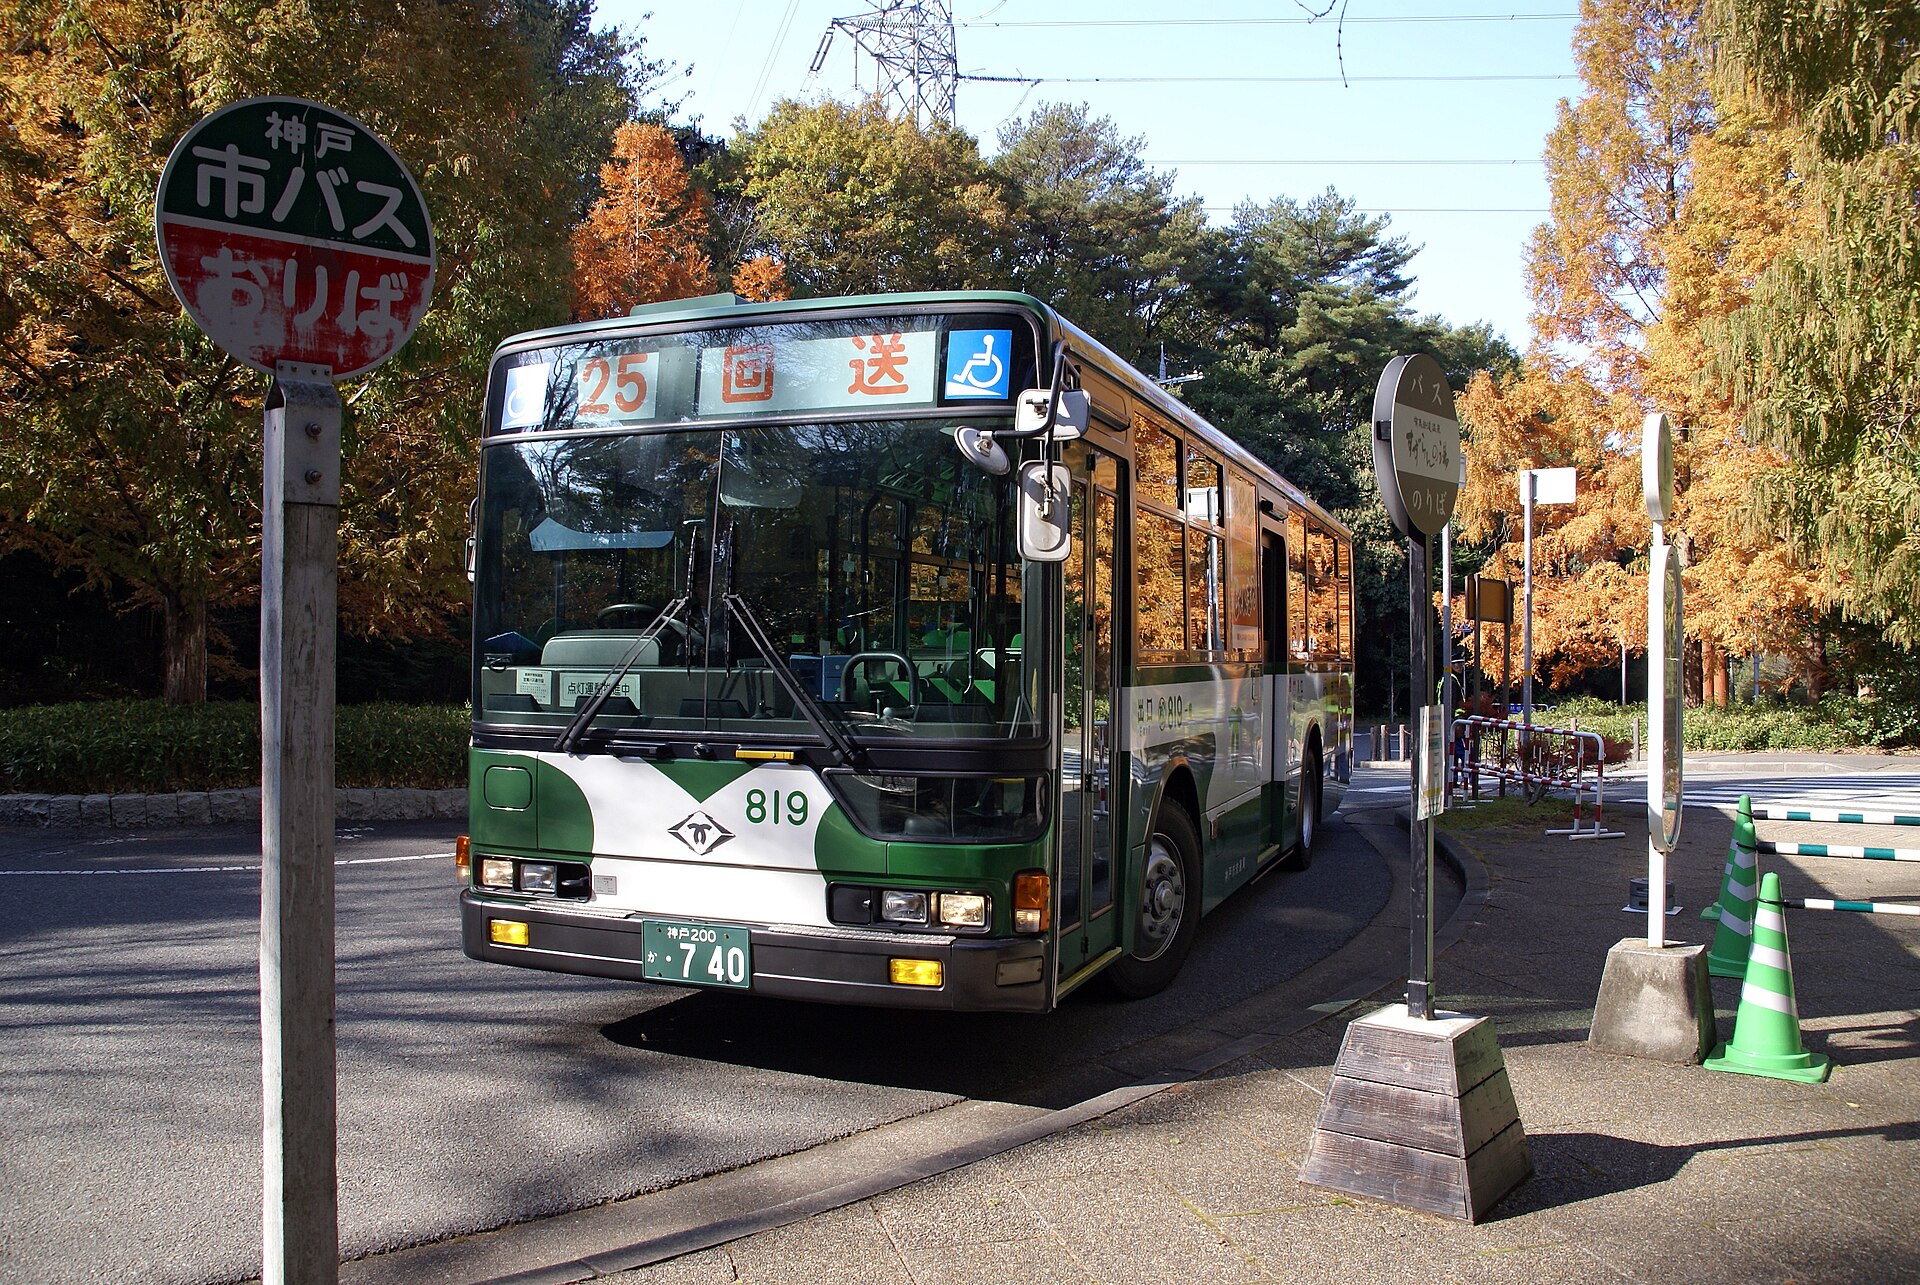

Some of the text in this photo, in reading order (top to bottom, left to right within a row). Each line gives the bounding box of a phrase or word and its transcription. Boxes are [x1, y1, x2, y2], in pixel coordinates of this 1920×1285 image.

[265, 110, 355, 158] 神戸
[192, 143, 416, 248] 市バス
[199, 247, 408, 337] おりば
[577, 352, 648, 416] 25
[1411, 374, 1442, 405] バス
[1412, 488, 1447, 516] のりば
[1137, 698, 1153, 722] 出口
[745, 788, 808, 826] 819
[666, 926, 716, 943] 神戸200
[647, 951, 658, 963] か
